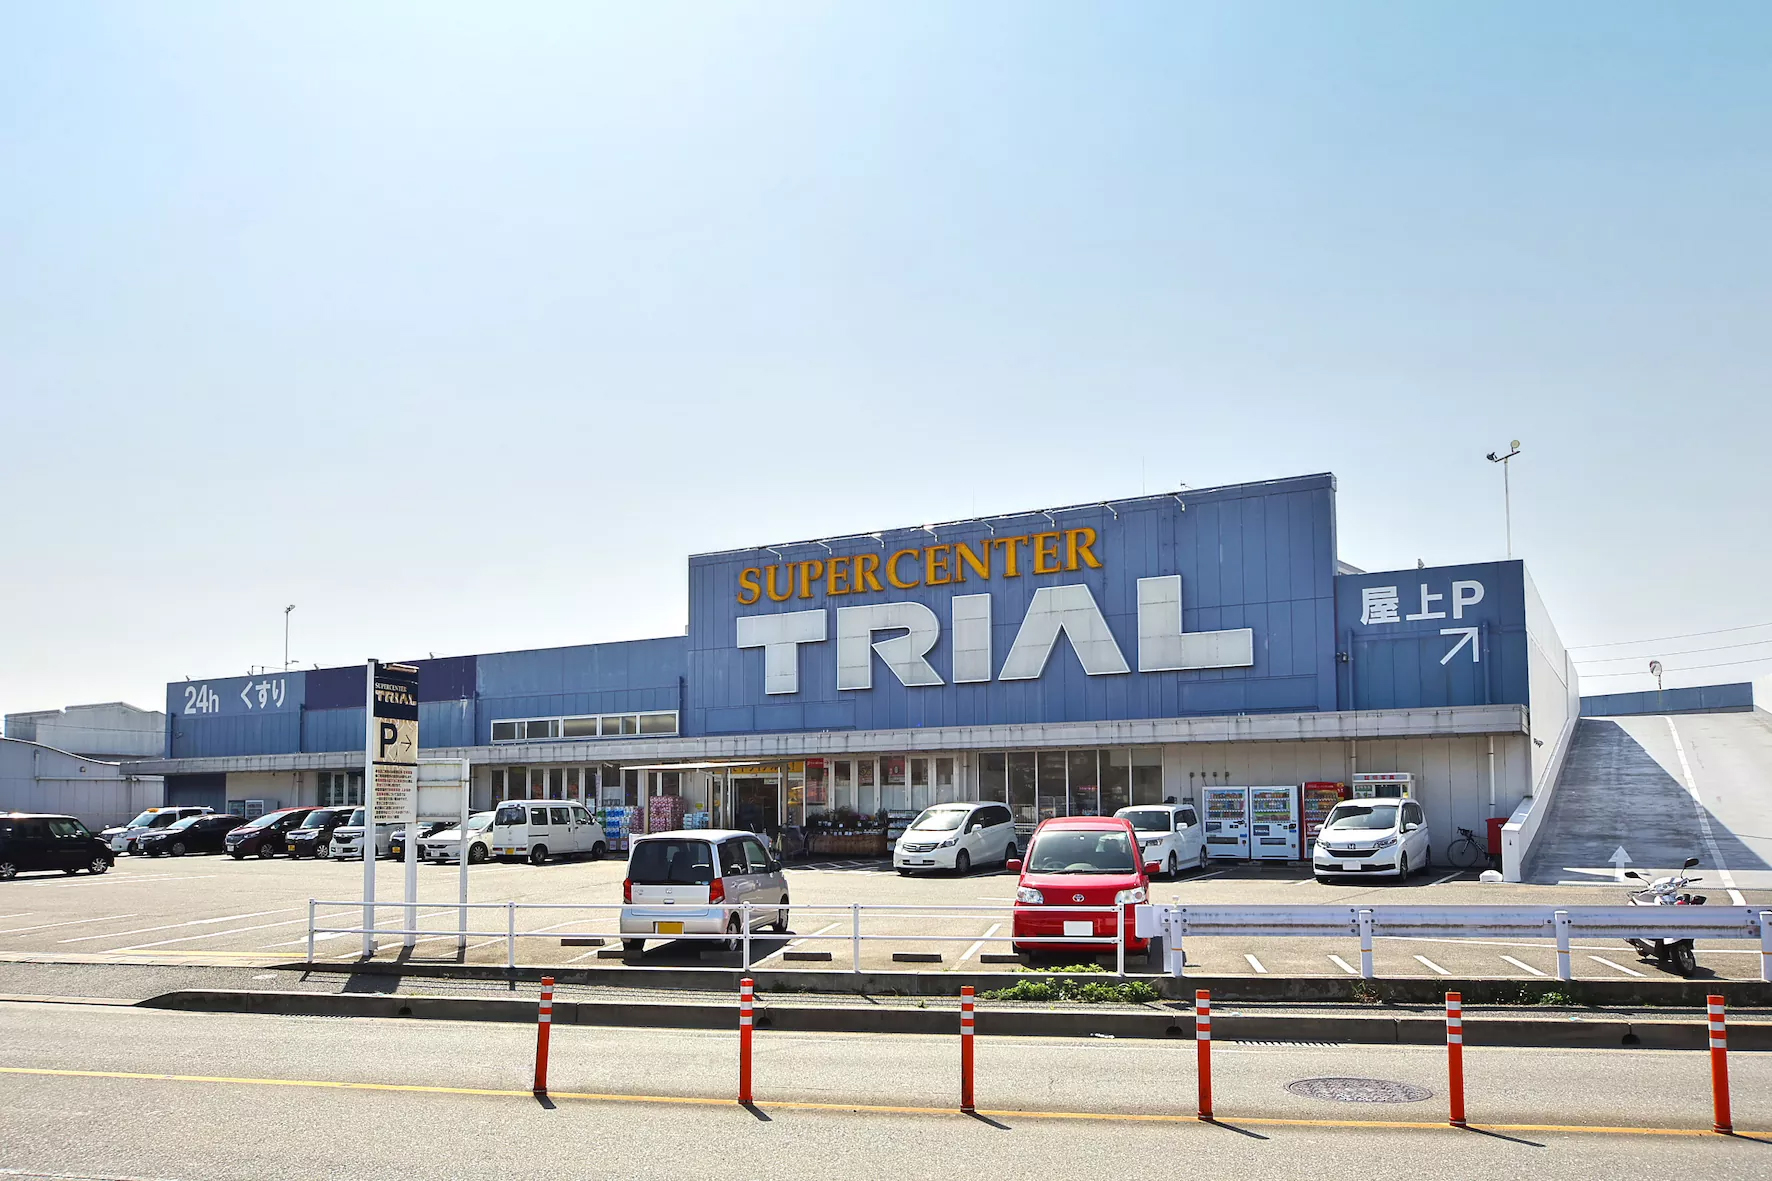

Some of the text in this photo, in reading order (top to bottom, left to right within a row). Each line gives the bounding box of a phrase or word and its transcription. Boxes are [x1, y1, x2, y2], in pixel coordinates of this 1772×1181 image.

[736, 527, 1103, 605] SUPERCENTER
[1360, 579, 1486, 626] 屋上P
[736, 574, 1254, 696] TRIAL
[184, 679, 286, 715] 24h くすり
[375, 682, 408, 692] SUPERCENTER
[375, 689, 417, 706] TRIAL
[380, 722, 398, 758] P
